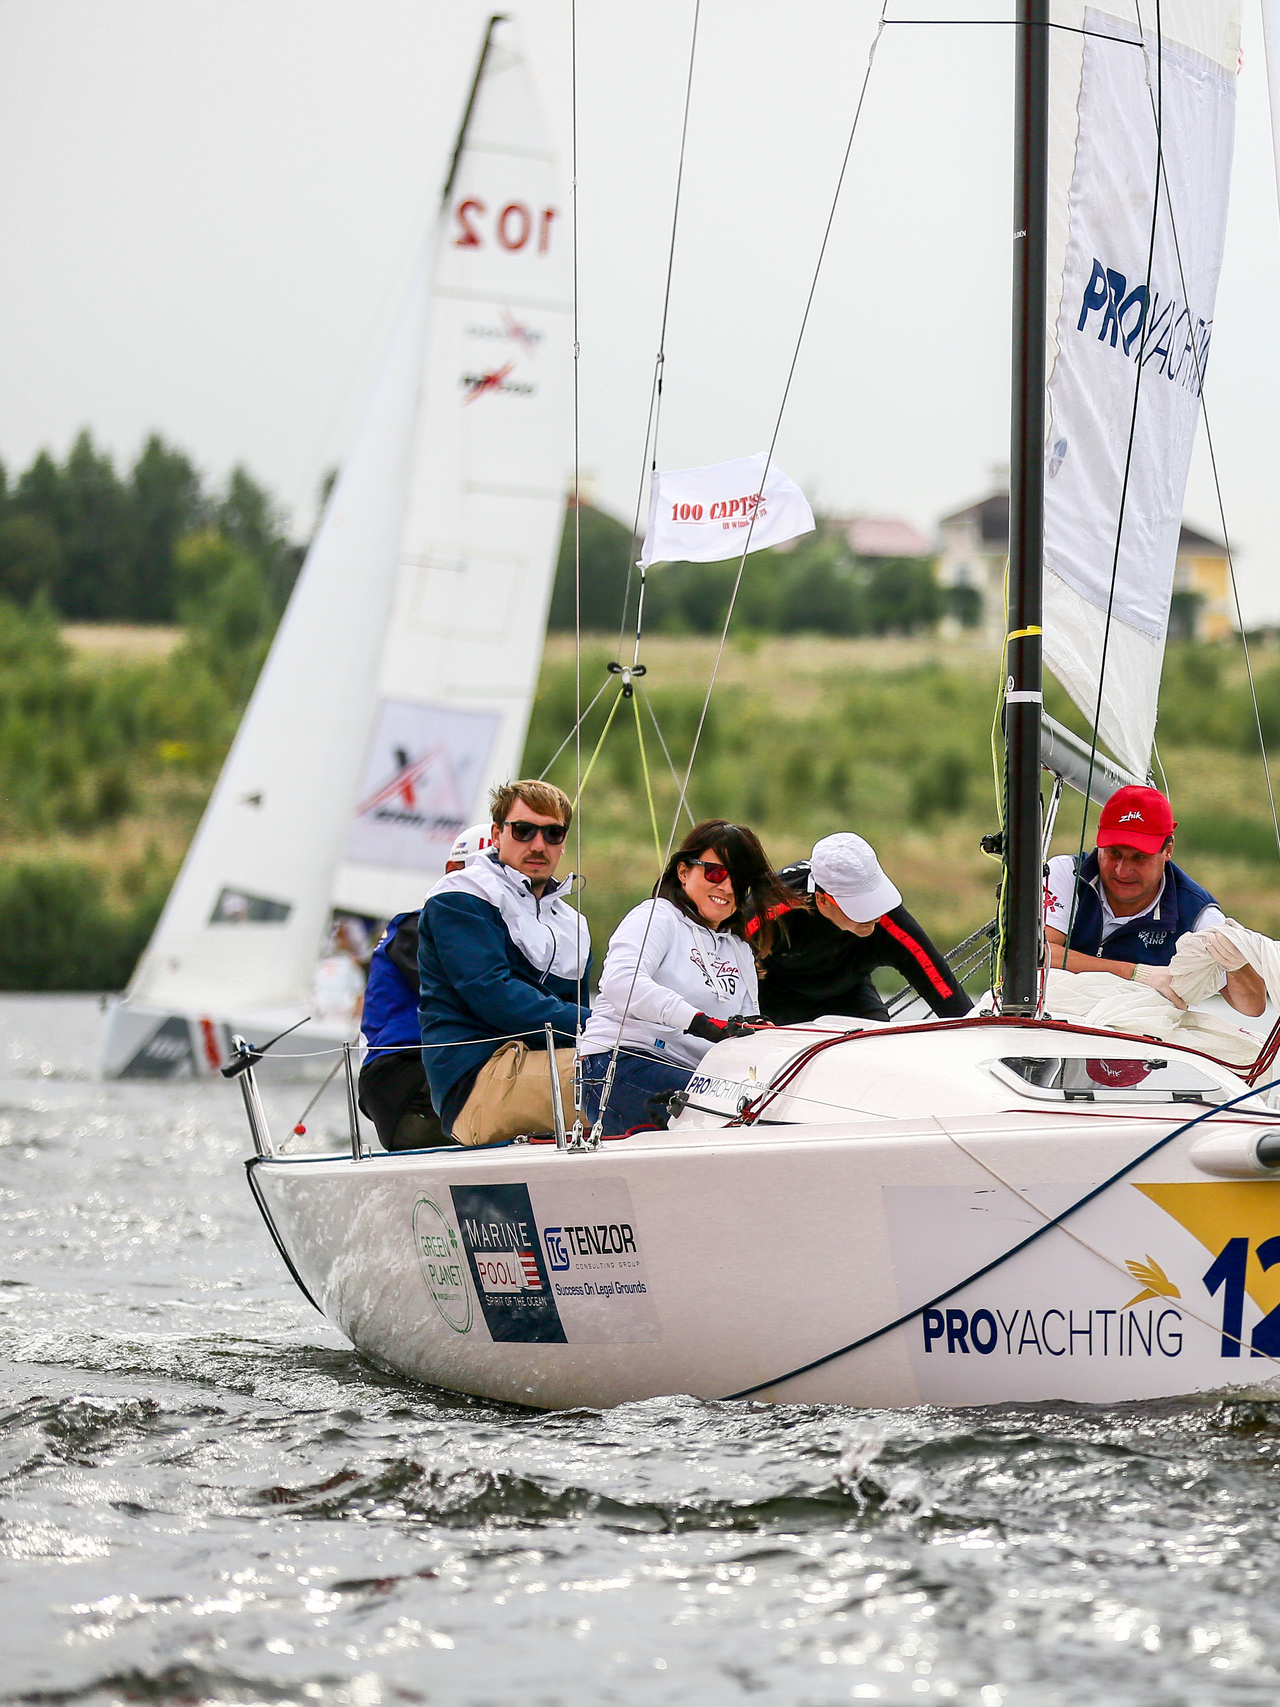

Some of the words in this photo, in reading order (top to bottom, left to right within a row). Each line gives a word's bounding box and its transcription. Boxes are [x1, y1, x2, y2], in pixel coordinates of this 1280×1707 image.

[671, 502, 703, 521] 100
[1119, 811, 1145, 823] zhik
[465, 1219, 532, 1247] MARINE
[564, 1224, 637, 1255] TENZOR
[421, 1236, 451, 1257] GREEN
[428, 1264, 463, 1286] PLANET
[478, 1262, 516, 1285] POOL
[575, 1262, 615, 1270] CONSULTING
[619, 1260, 640, 1268] GROUP
[555, 1283, 584, 1296] Success
[583, 1282, 596, 1295] On
[594, 1281, 615, 1298] Legal
[614, 1280, 647, 1294] Grounds
[485, 1294, 504, 1306] SPIRIT
[504, 1296, 512, 1306] OF
[512, 1296, 527, 1306] THE
[526, 1296, 548, 1306] OCEAN
[922, 1308, 1183, 1358] PROYACHTING
